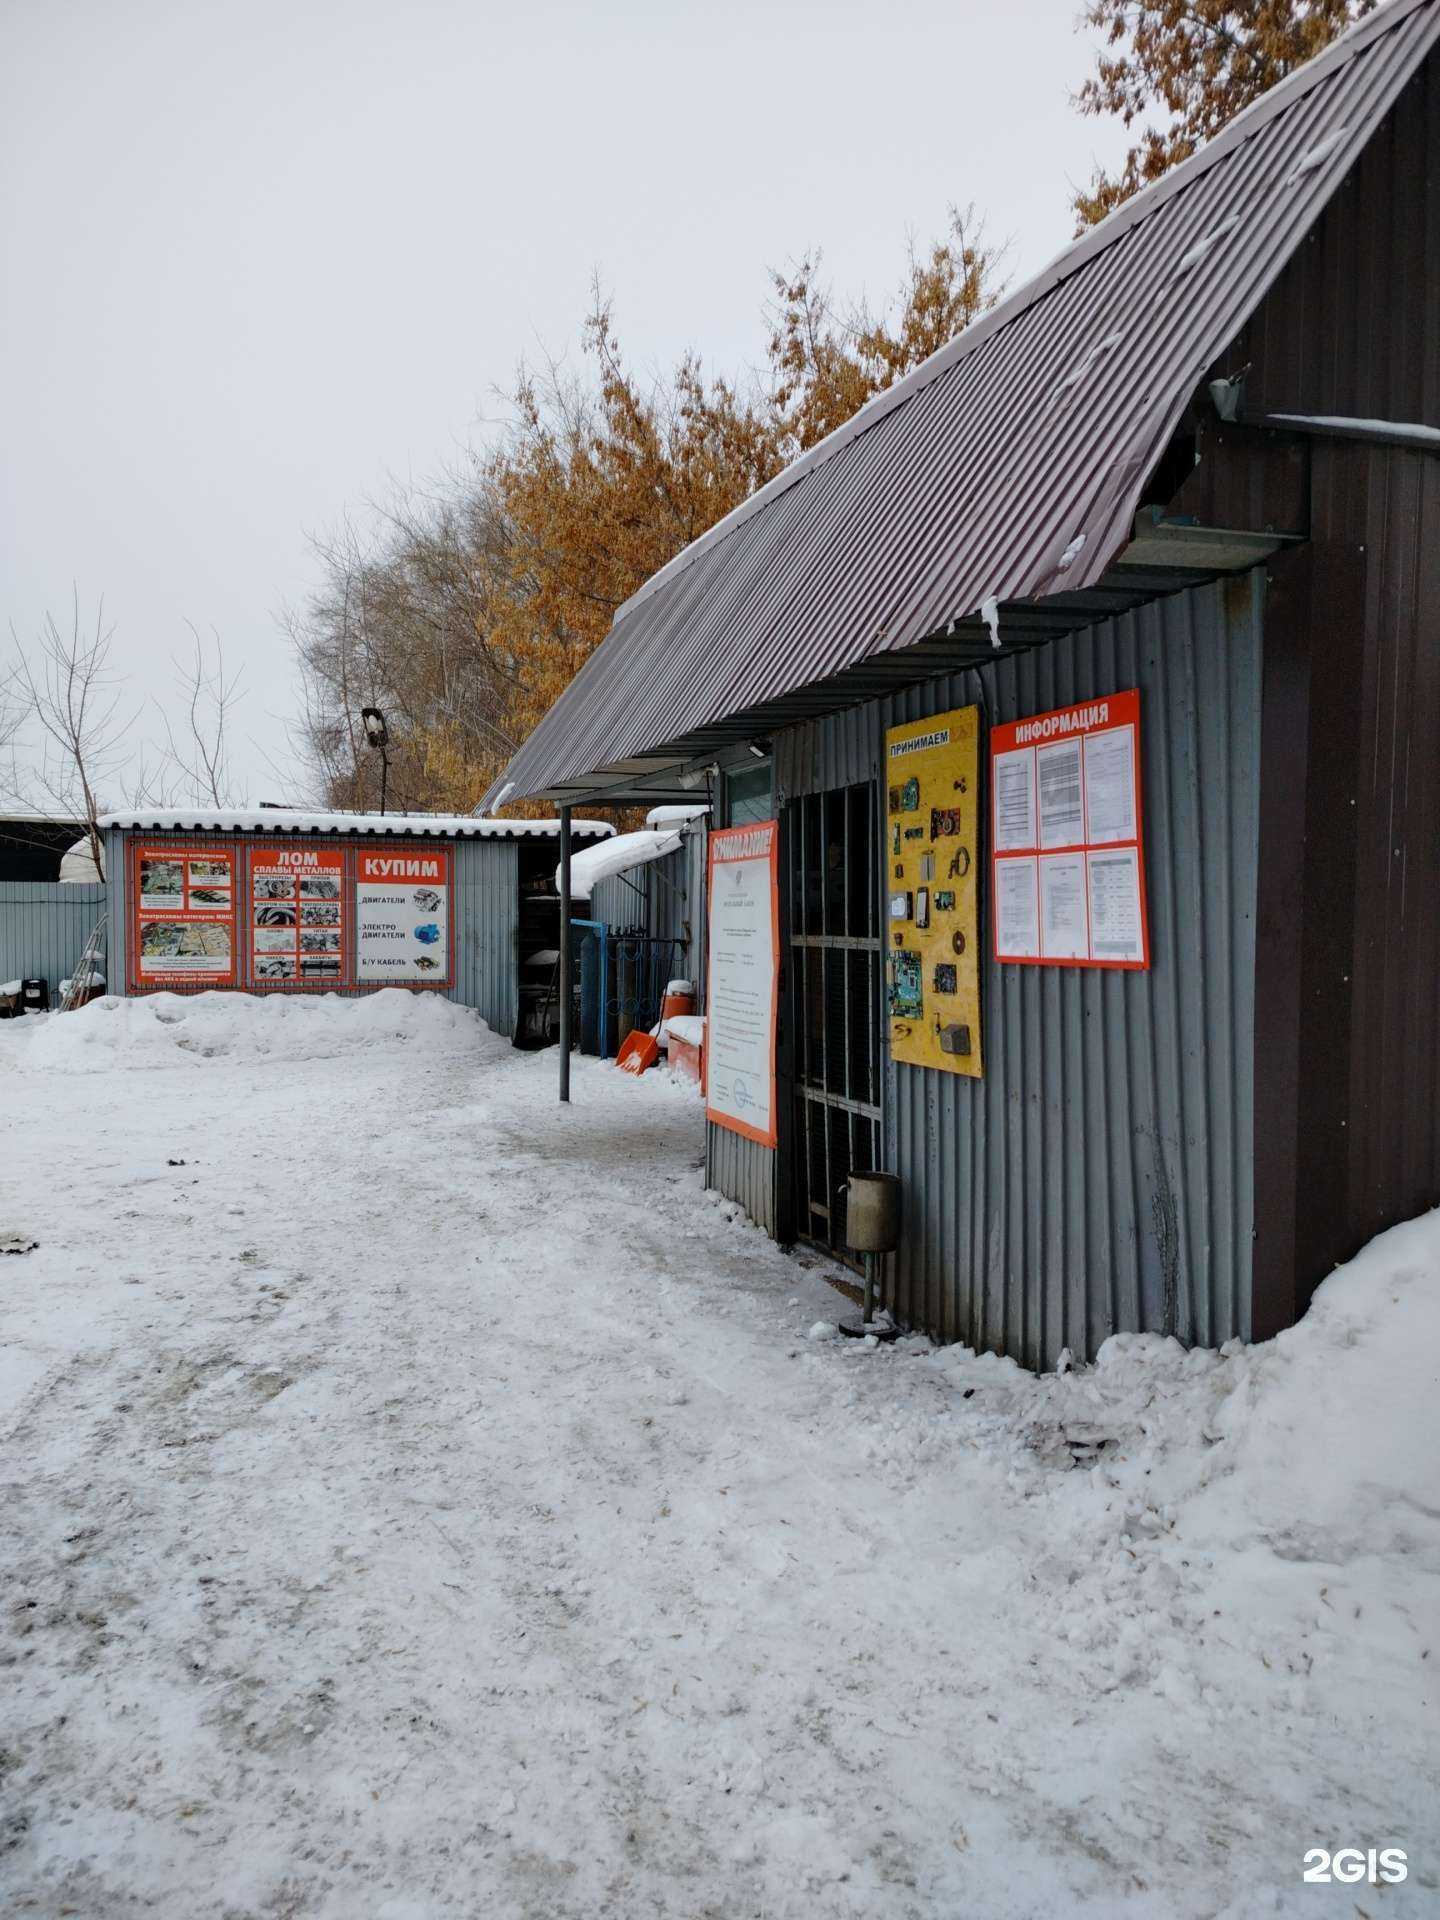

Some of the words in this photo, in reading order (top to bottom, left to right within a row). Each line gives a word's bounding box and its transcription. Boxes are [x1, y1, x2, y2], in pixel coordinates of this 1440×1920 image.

[1015, 703, 1109, 744] ИНФОРМАЦИЯ
[890, 730, 949, 756] ПРИНИМАЕМ
[277, 852, 318, 866] ЛОМ
[254, 866, 291, 874] СПЛАВЫ
[293, 866, 341, 875] МЕТАЛЛОВ
[365, 858, 439, 877] КУПИМ
[362, 896, 406, 905] ДВИГАТЕЛИ
[362, 931, 406, 940] ДВИГАТЕЛИ
